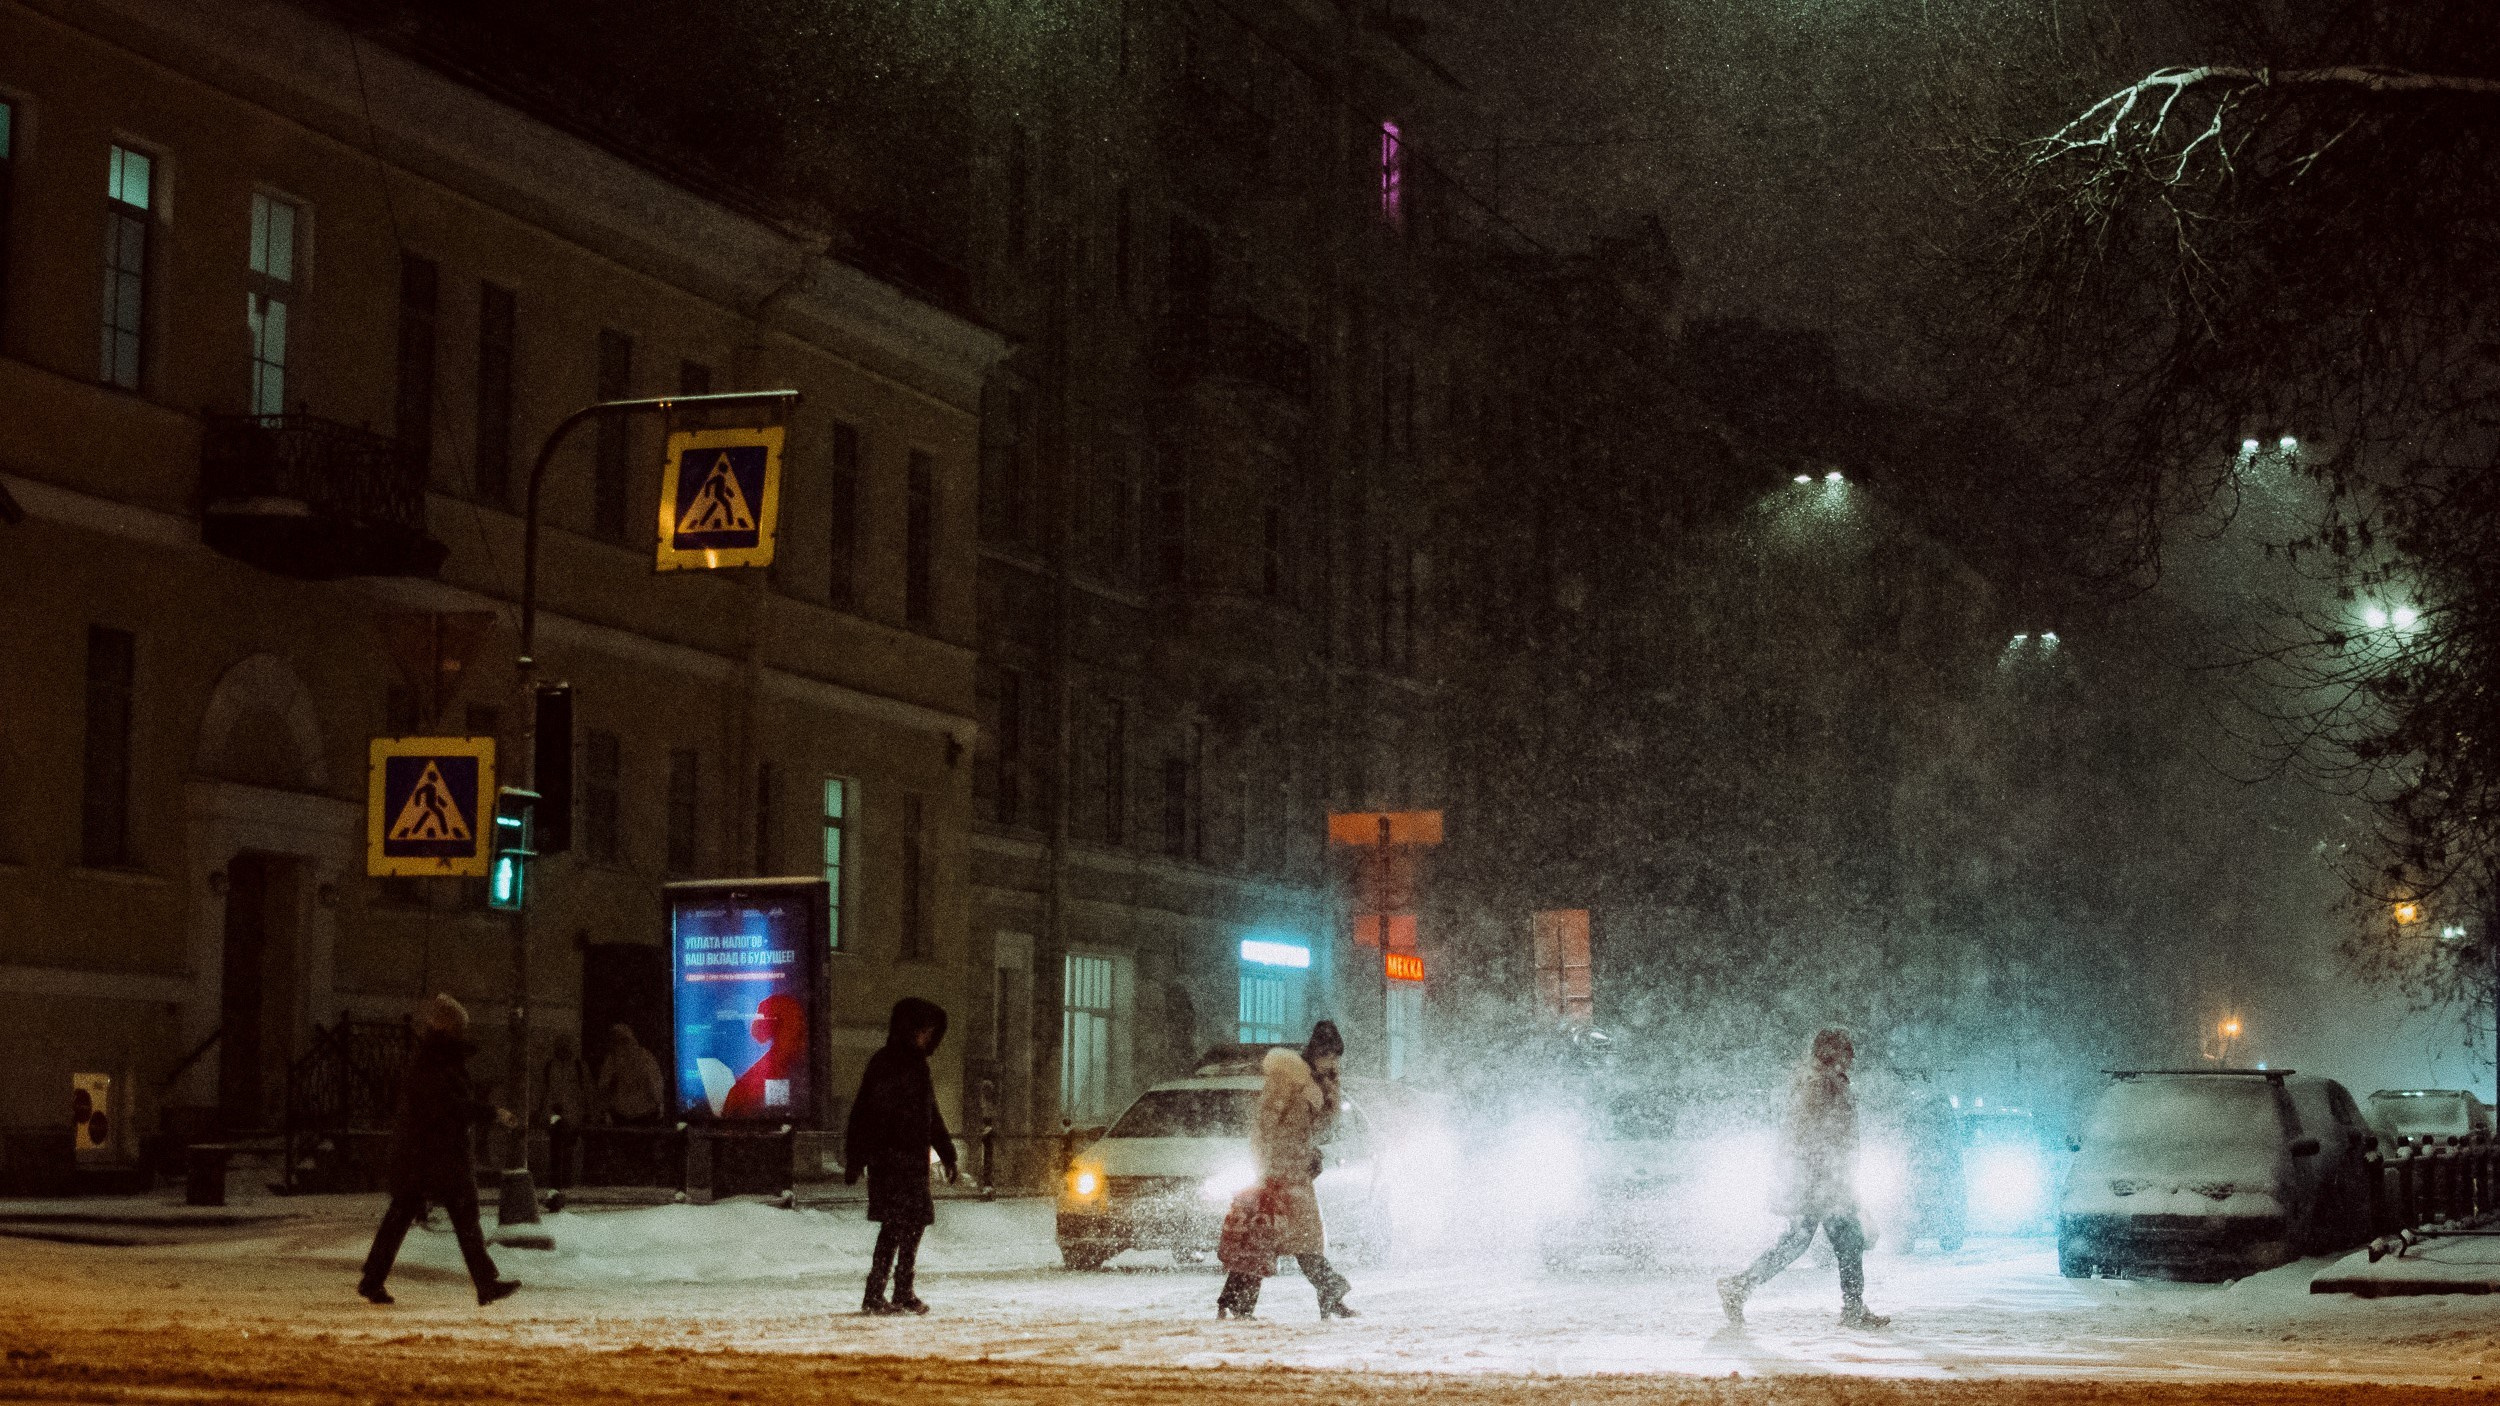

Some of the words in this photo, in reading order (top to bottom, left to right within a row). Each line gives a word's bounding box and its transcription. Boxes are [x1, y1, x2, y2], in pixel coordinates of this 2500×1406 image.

[684, 937, 721, 949] УПЛАТА
[722, 935, 763, 948] НАЛОГОВ
[684, 953, 705, 966] ВАШ
[707, 952, 738, 965] ВКЛАД
[740, 952, 746, 964] В
[748, 950, 795, 964] БУДУЩЕЕ!
